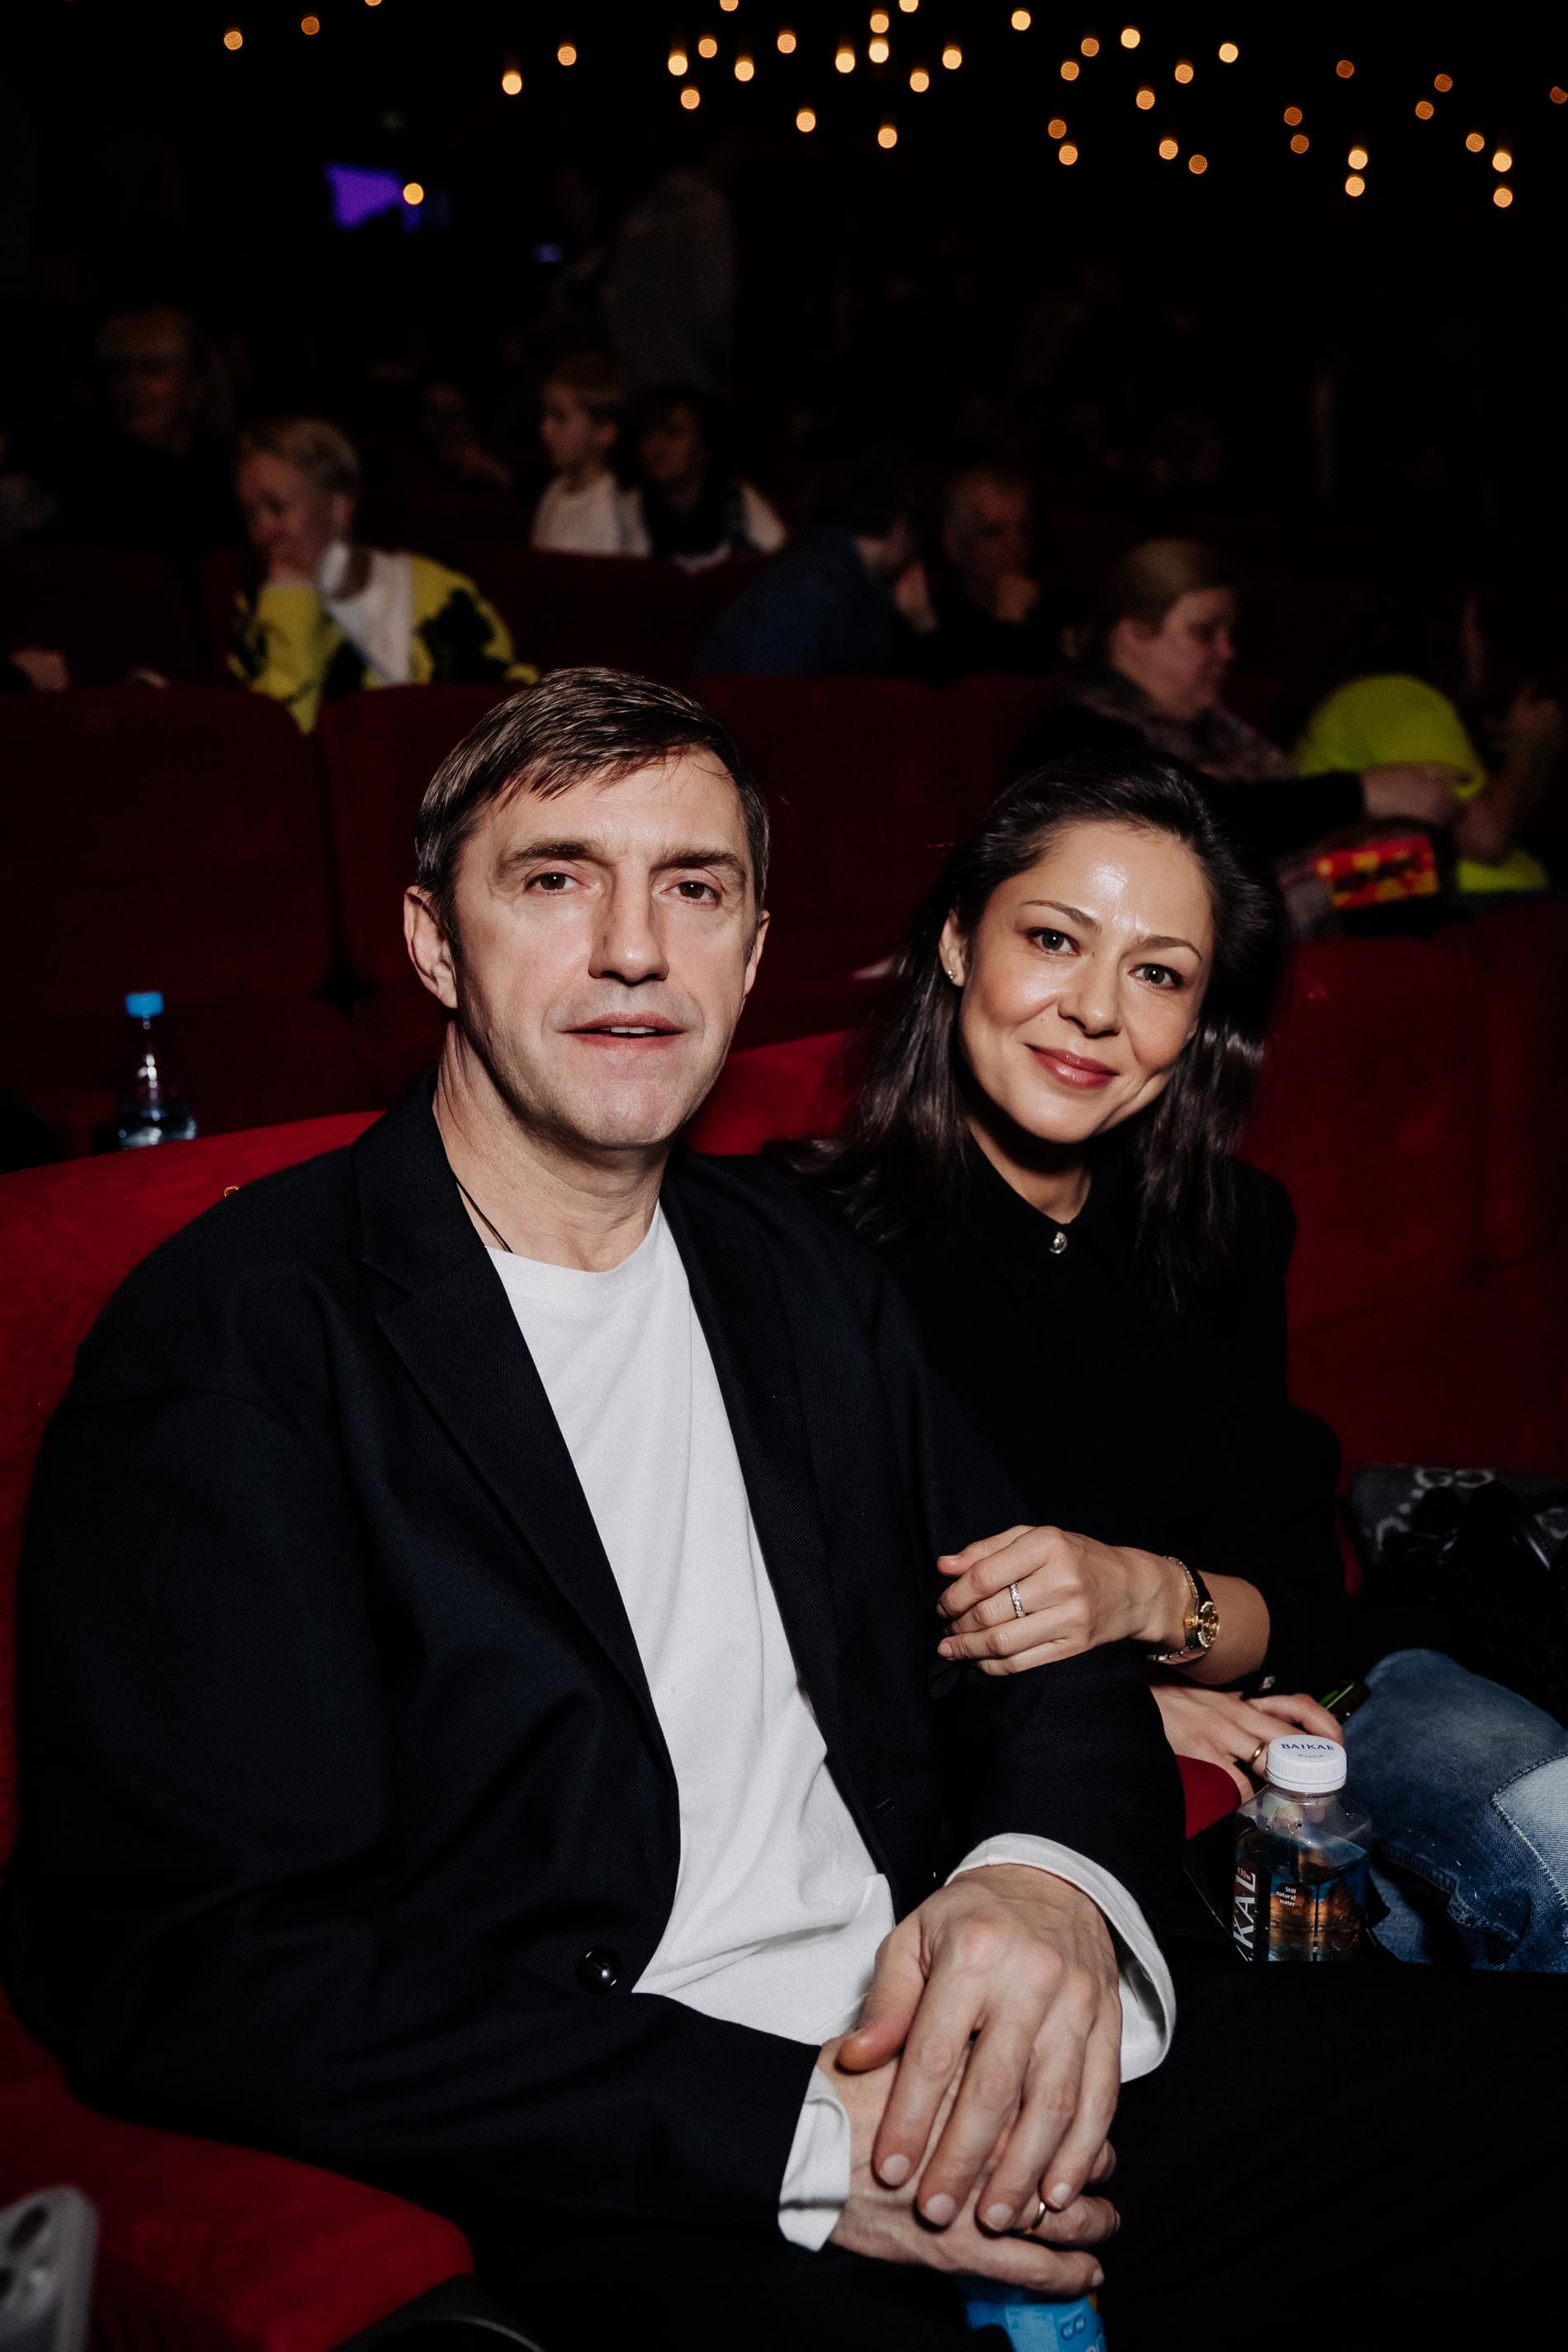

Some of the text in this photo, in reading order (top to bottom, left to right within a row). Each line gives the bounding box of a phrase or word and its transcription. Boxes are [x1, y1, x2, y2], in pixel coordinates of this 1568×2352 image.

[1284, 1886, 1296, 1894] Still
[1275, 1891, 1296, 1901] natural
[1279, 1898, 1296, 1907] water
[1233, 1872, 1256, 1962] KAL
